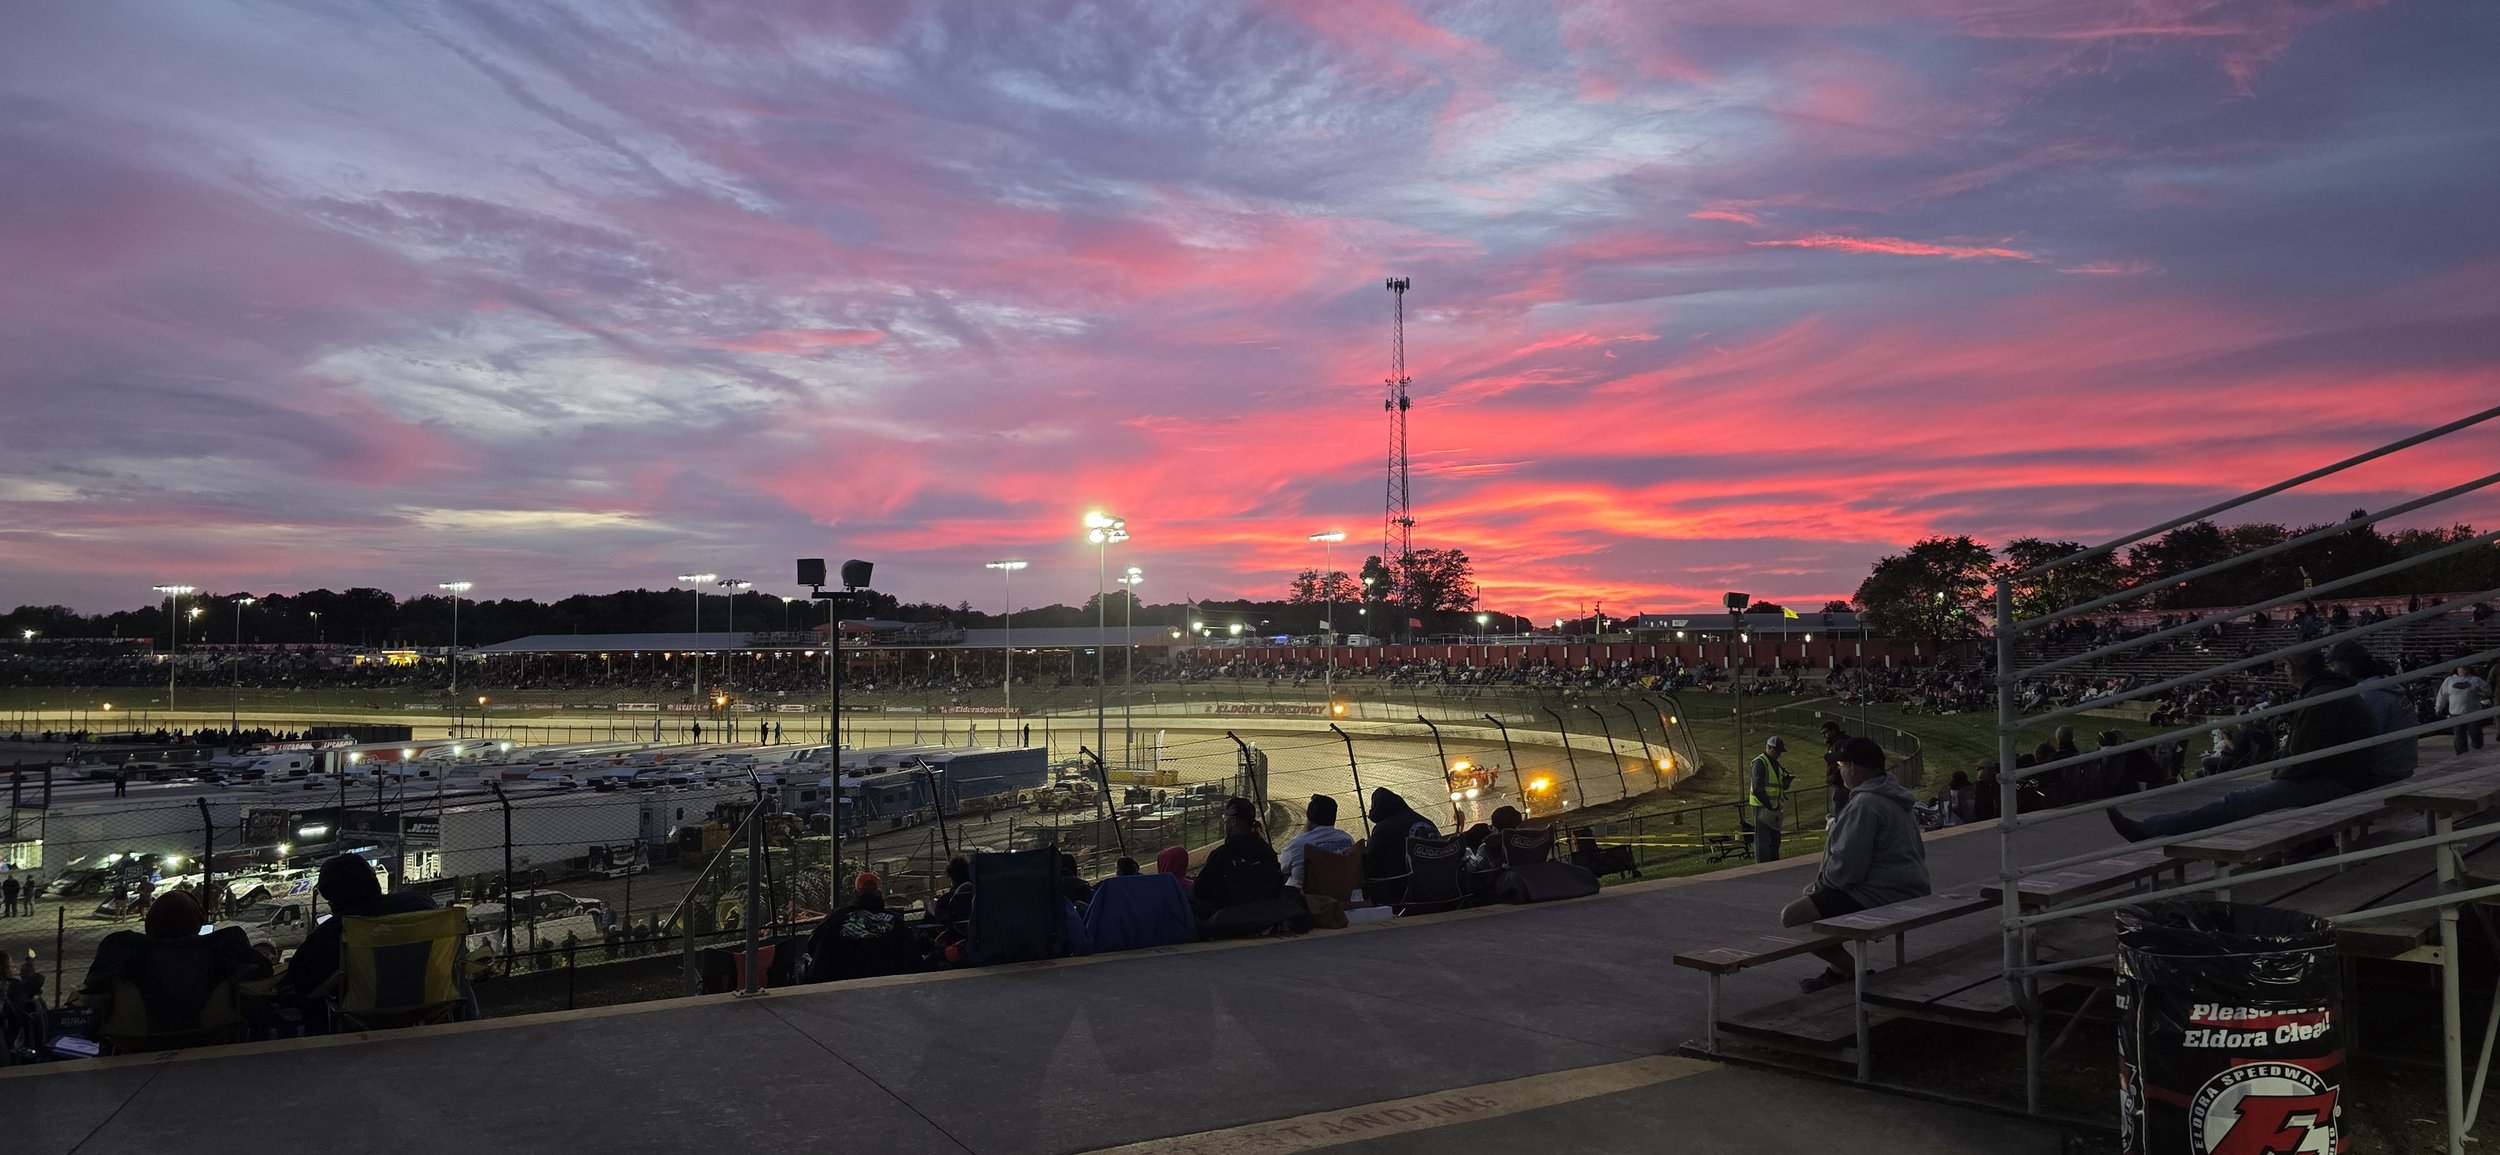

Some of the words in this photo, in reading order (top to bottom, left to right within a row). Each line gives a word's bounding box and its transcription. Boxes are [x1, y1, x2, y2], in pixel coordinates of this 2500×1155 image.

[290, 880, 311, 895] 22
[2182, 1029, 2268, 1049] Eldora
[2191, 1087, 2220, 1150] ELDORA
[2221, 1064, 2321, 1090] SPEEDWAY
